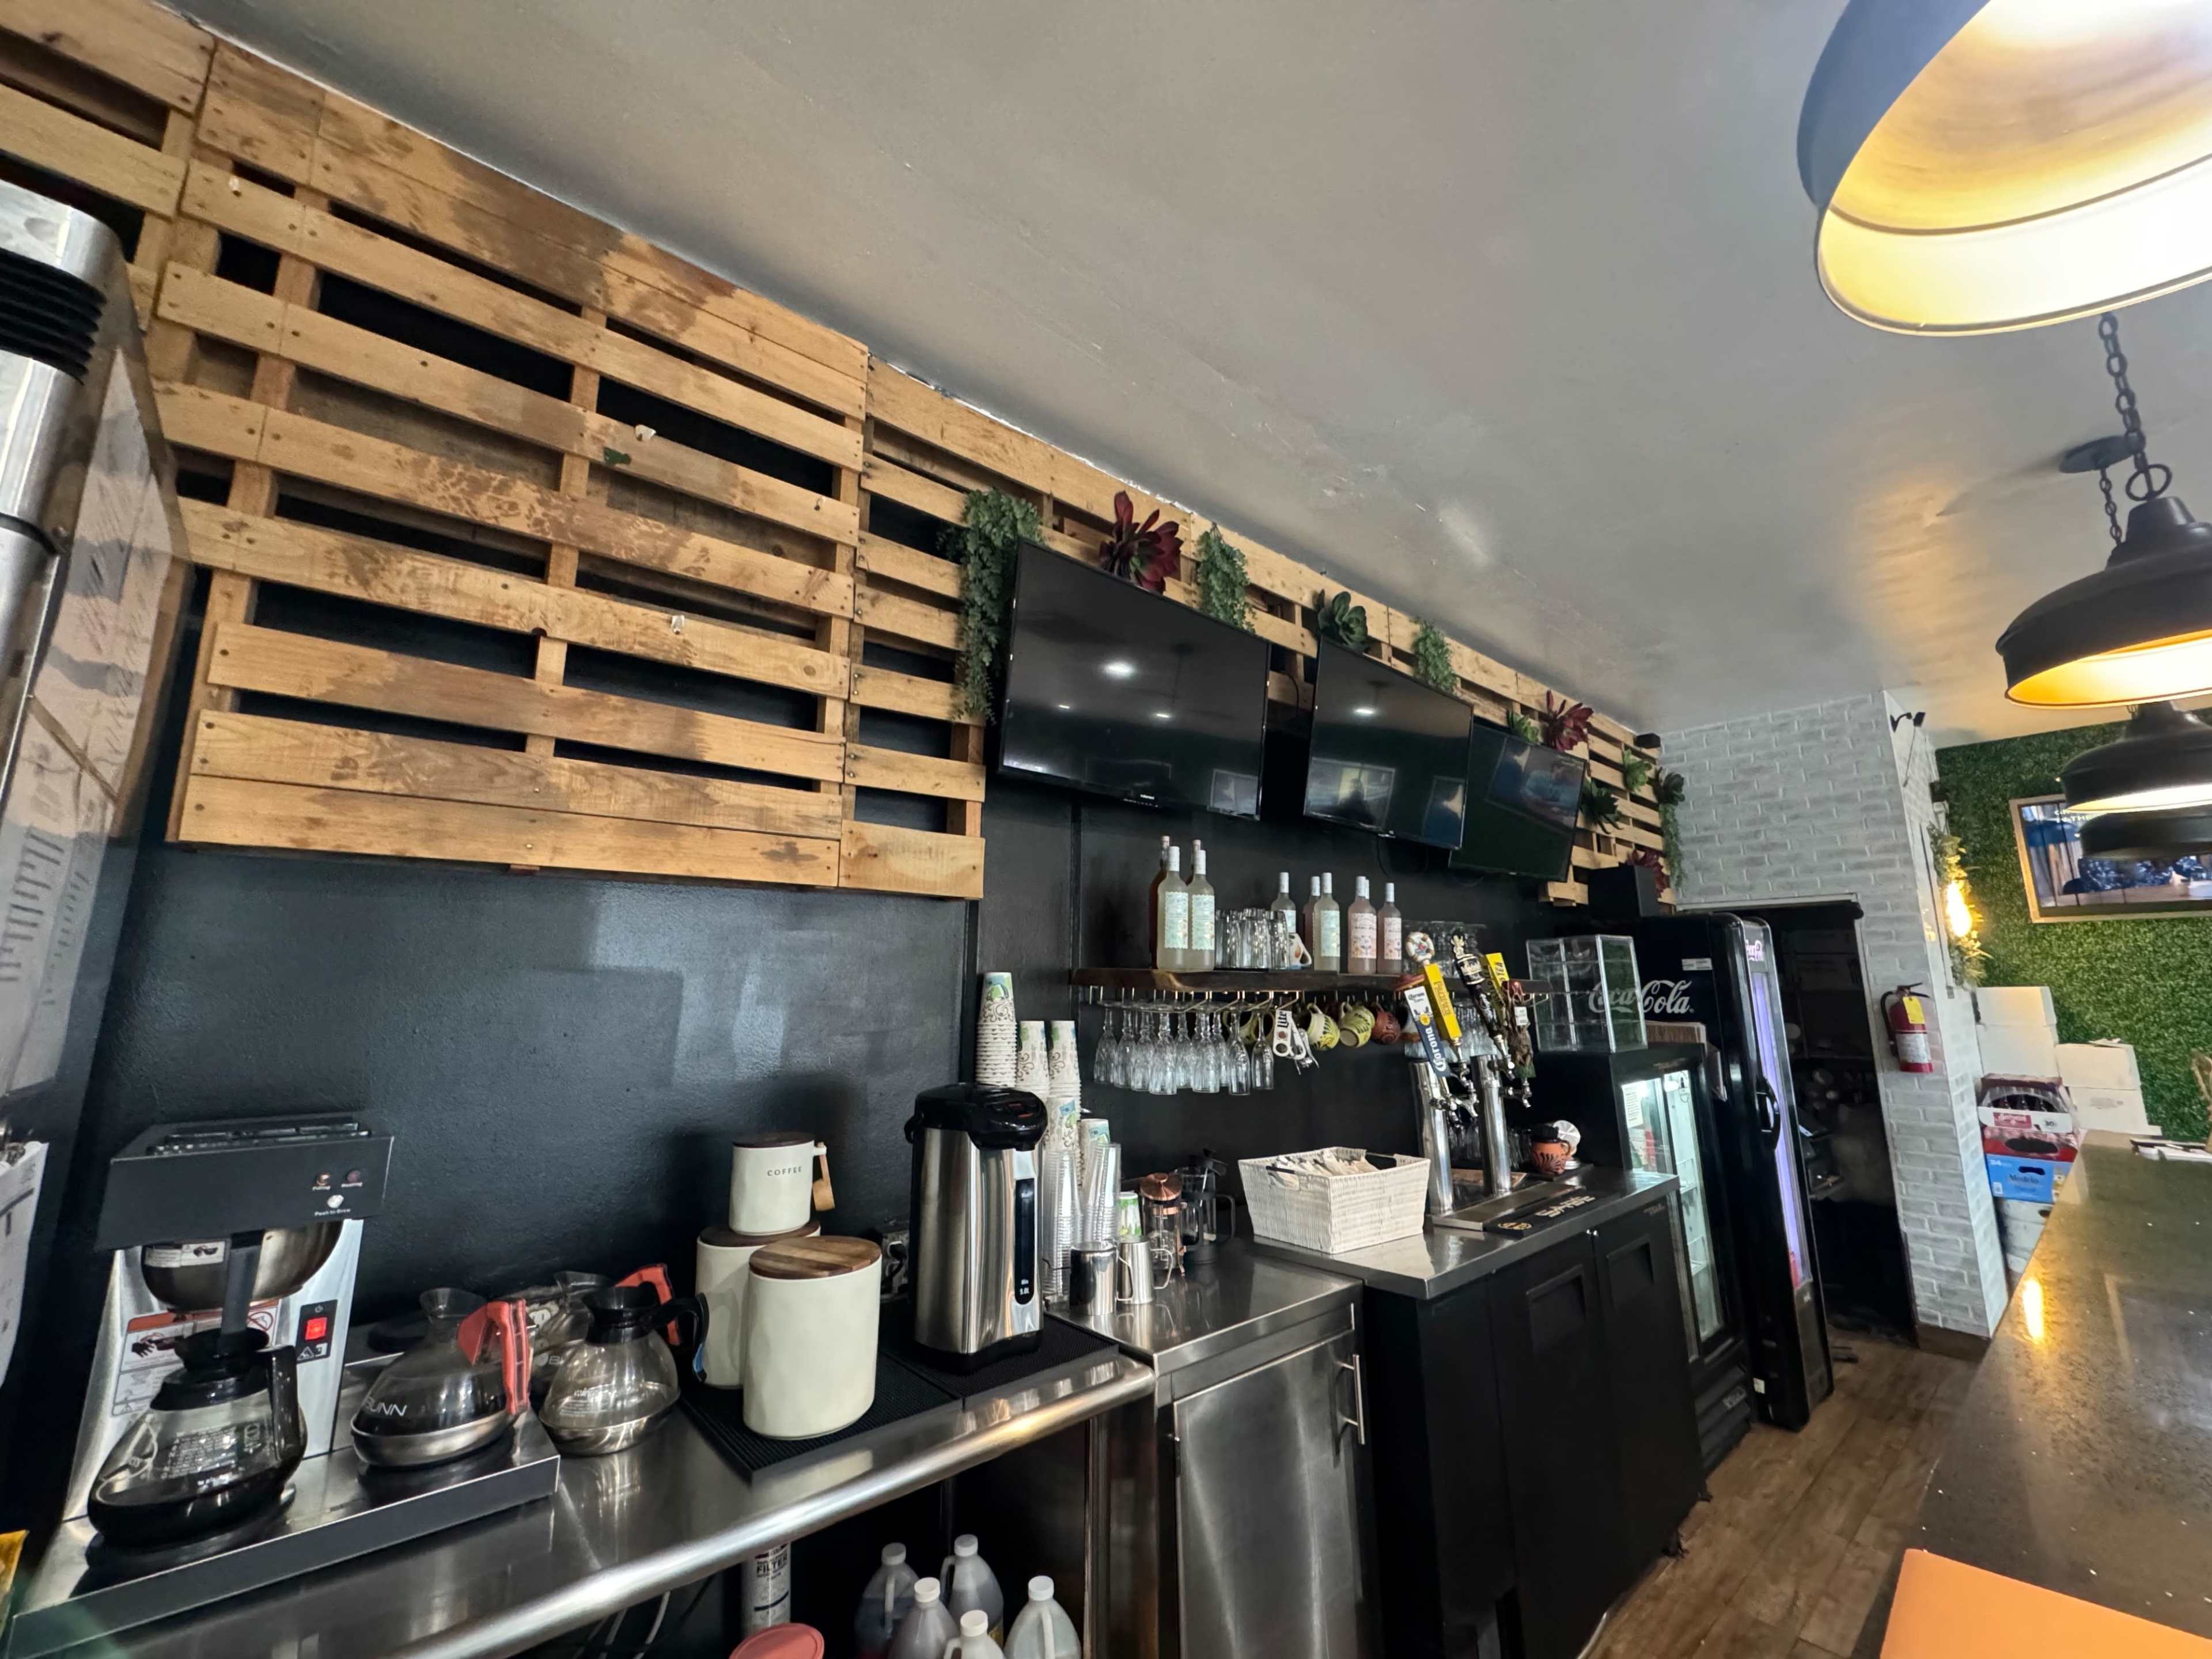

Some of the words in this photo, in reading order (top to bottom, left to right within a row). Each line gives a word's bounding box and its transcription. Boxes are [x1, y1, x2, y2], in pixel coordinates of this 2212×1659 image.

[1588, 980, 1692, 1014] CocaCola
[1277, 1012, 1289, 1028] Lite
[1425, 1026, 1446, 1072] Corona
[767, 1166, 802, 1176] COFFEE
[363, 1396, 407, 1416] BUNN
